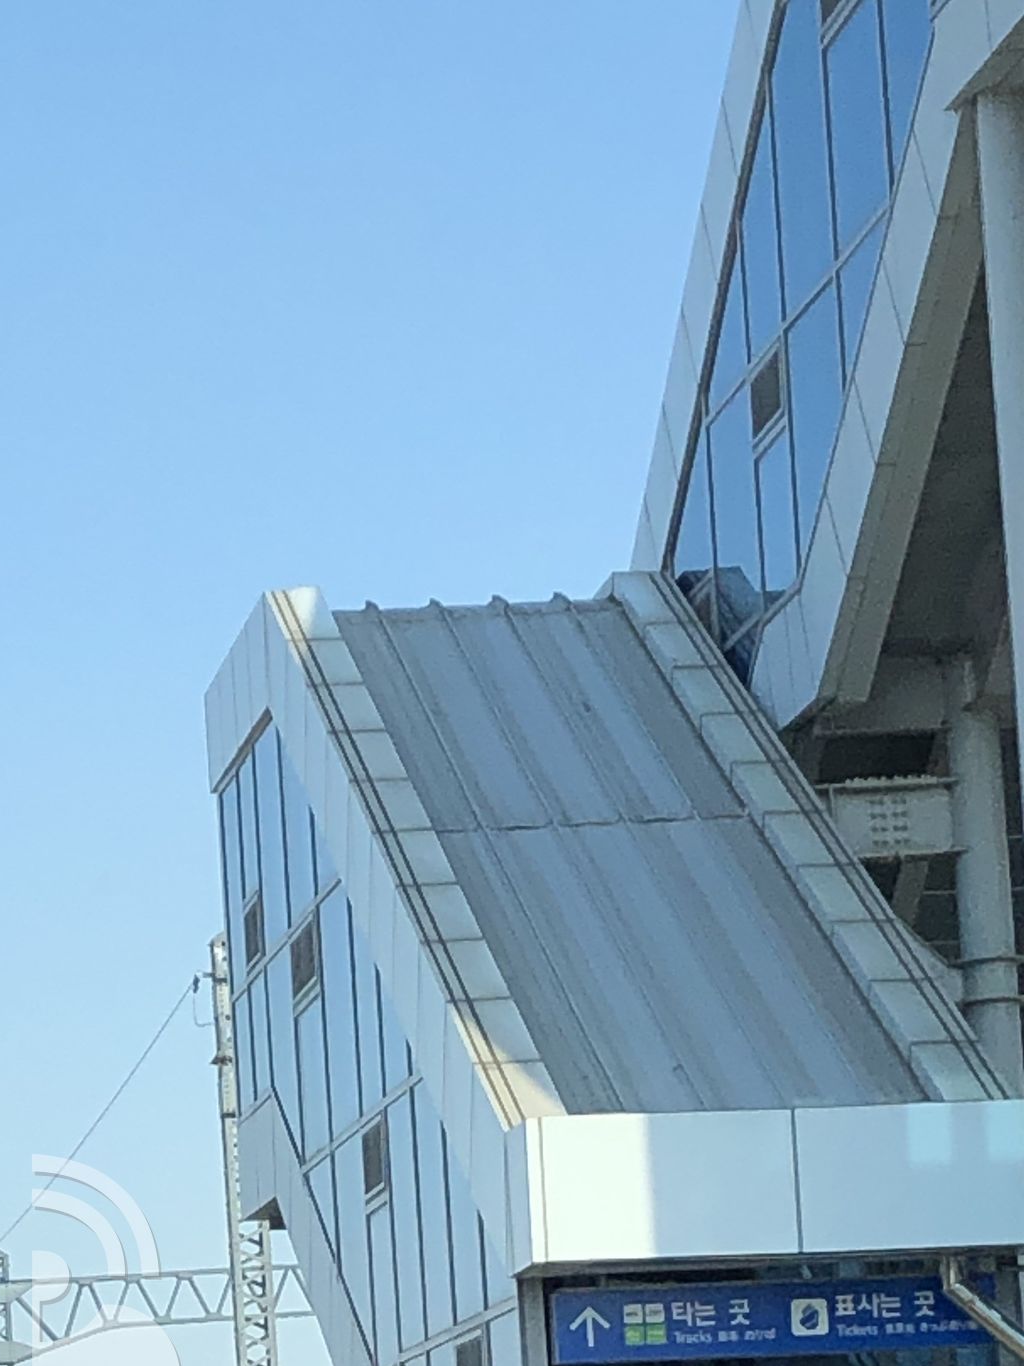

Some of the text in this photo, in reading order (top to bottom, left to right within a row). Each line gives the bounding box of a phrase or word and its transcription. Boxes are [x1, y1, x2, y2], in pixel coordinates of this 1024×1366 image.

[671, 1298, 750, 1327] 타는 곳
[834, 1290, 936, 1318] 표사는 곳
